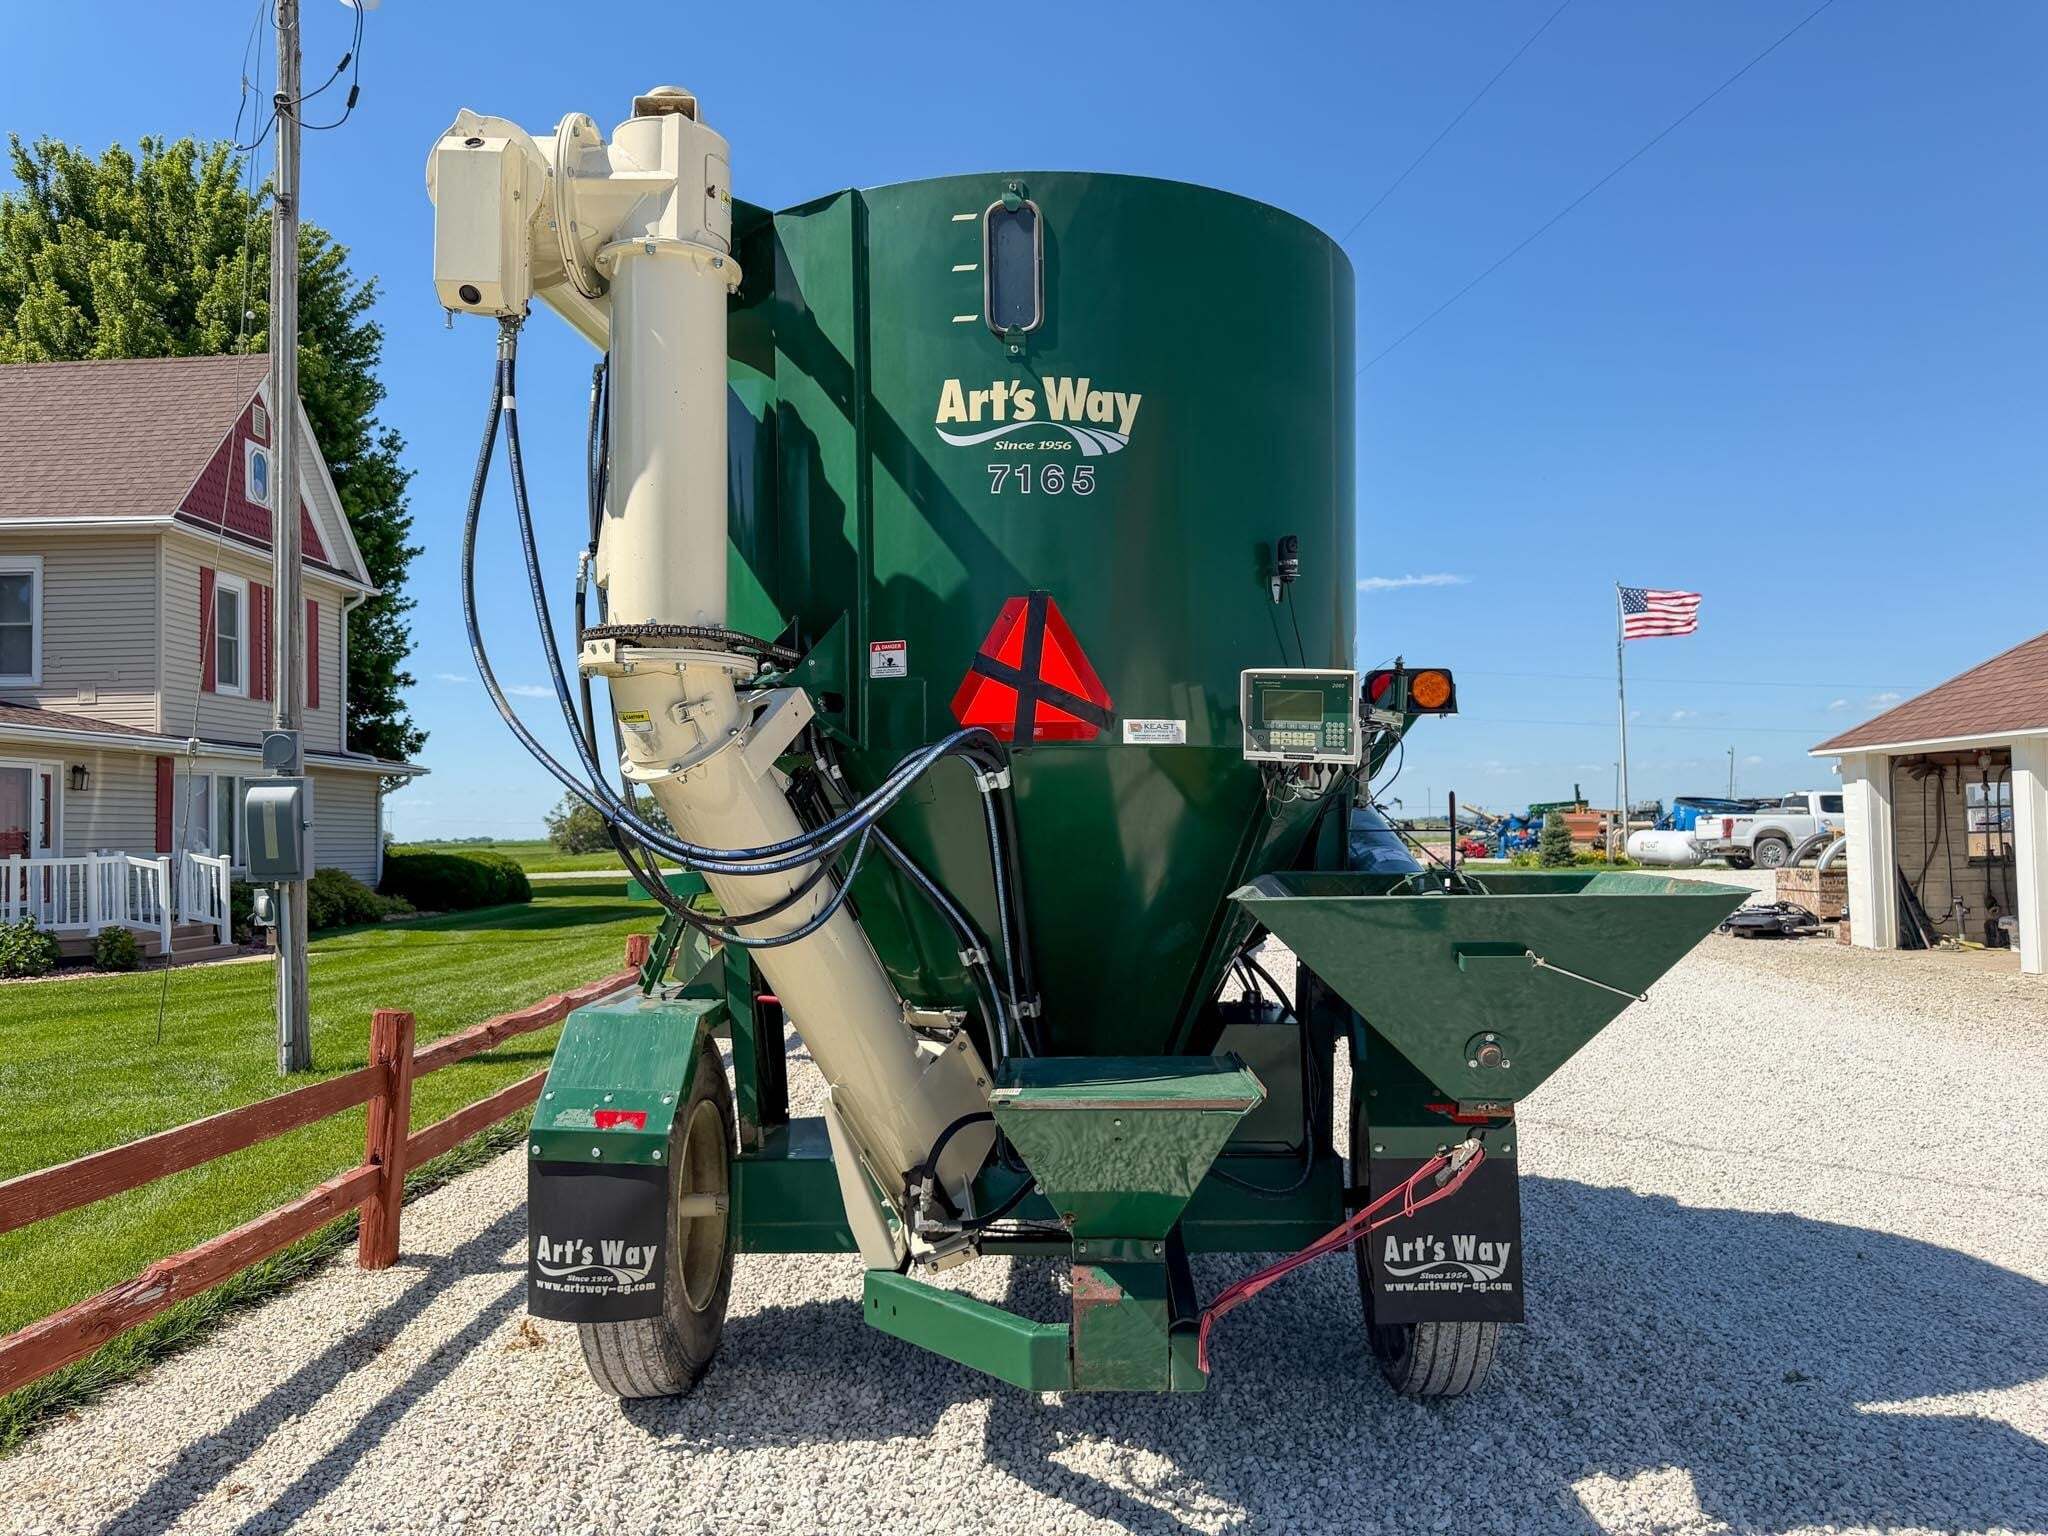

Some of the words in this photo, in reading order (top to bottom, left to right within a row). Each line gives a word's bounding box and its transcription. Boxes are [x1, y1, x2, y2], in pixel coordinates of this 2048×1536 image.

[935, 378, 1036, 424] Art's
[1041, 376, 1142, 436] Way
[994, 440, 1035, 450] Since
[1038, 440, 1072, 450] 1956
[987, 463, 1096, 496] 7165
[537, 1235, 593, 1265] Art's
[600, 1239, 658, 1275] Way
[1383, 1234, 1446, 1262] Art's
[1451, 1234, 1511, 1274] Way
[566, 1274, 590, 1282] Since
[591, 1275, 614, 1283] 1956
[1419, 1272, 1444, 1280] Since
[1445, 1272, 1468, 1280] 1956
[536, 1280, 656, 1296] www.artsway-ag.com
[1384, 1281, 1513, 1293] www.artsway-ag.com
